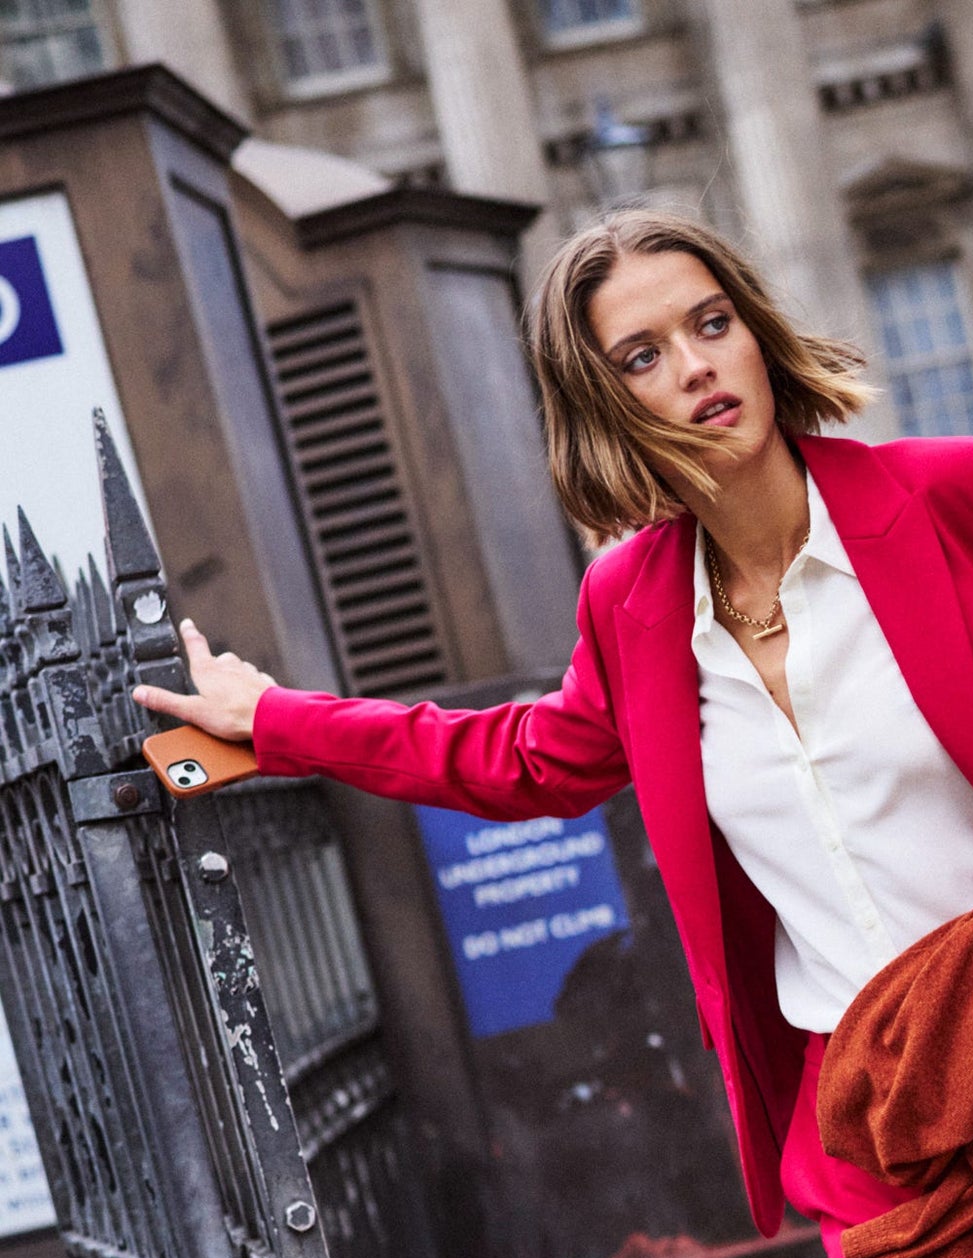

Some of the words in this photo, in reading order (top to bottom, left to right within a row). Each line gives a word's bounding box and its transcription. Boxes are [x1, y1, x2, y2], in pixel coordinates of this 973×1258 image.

[439, 832, 603, 888] UNDERGROUND
[467, 818, 563, 855] LONDON
[475, 865, 579, 907] PROPERTY
[464, 931, 497, 959] DO
[500, 919, 548, 950] NOT
[550, 905, 613, 938] CLIMB
